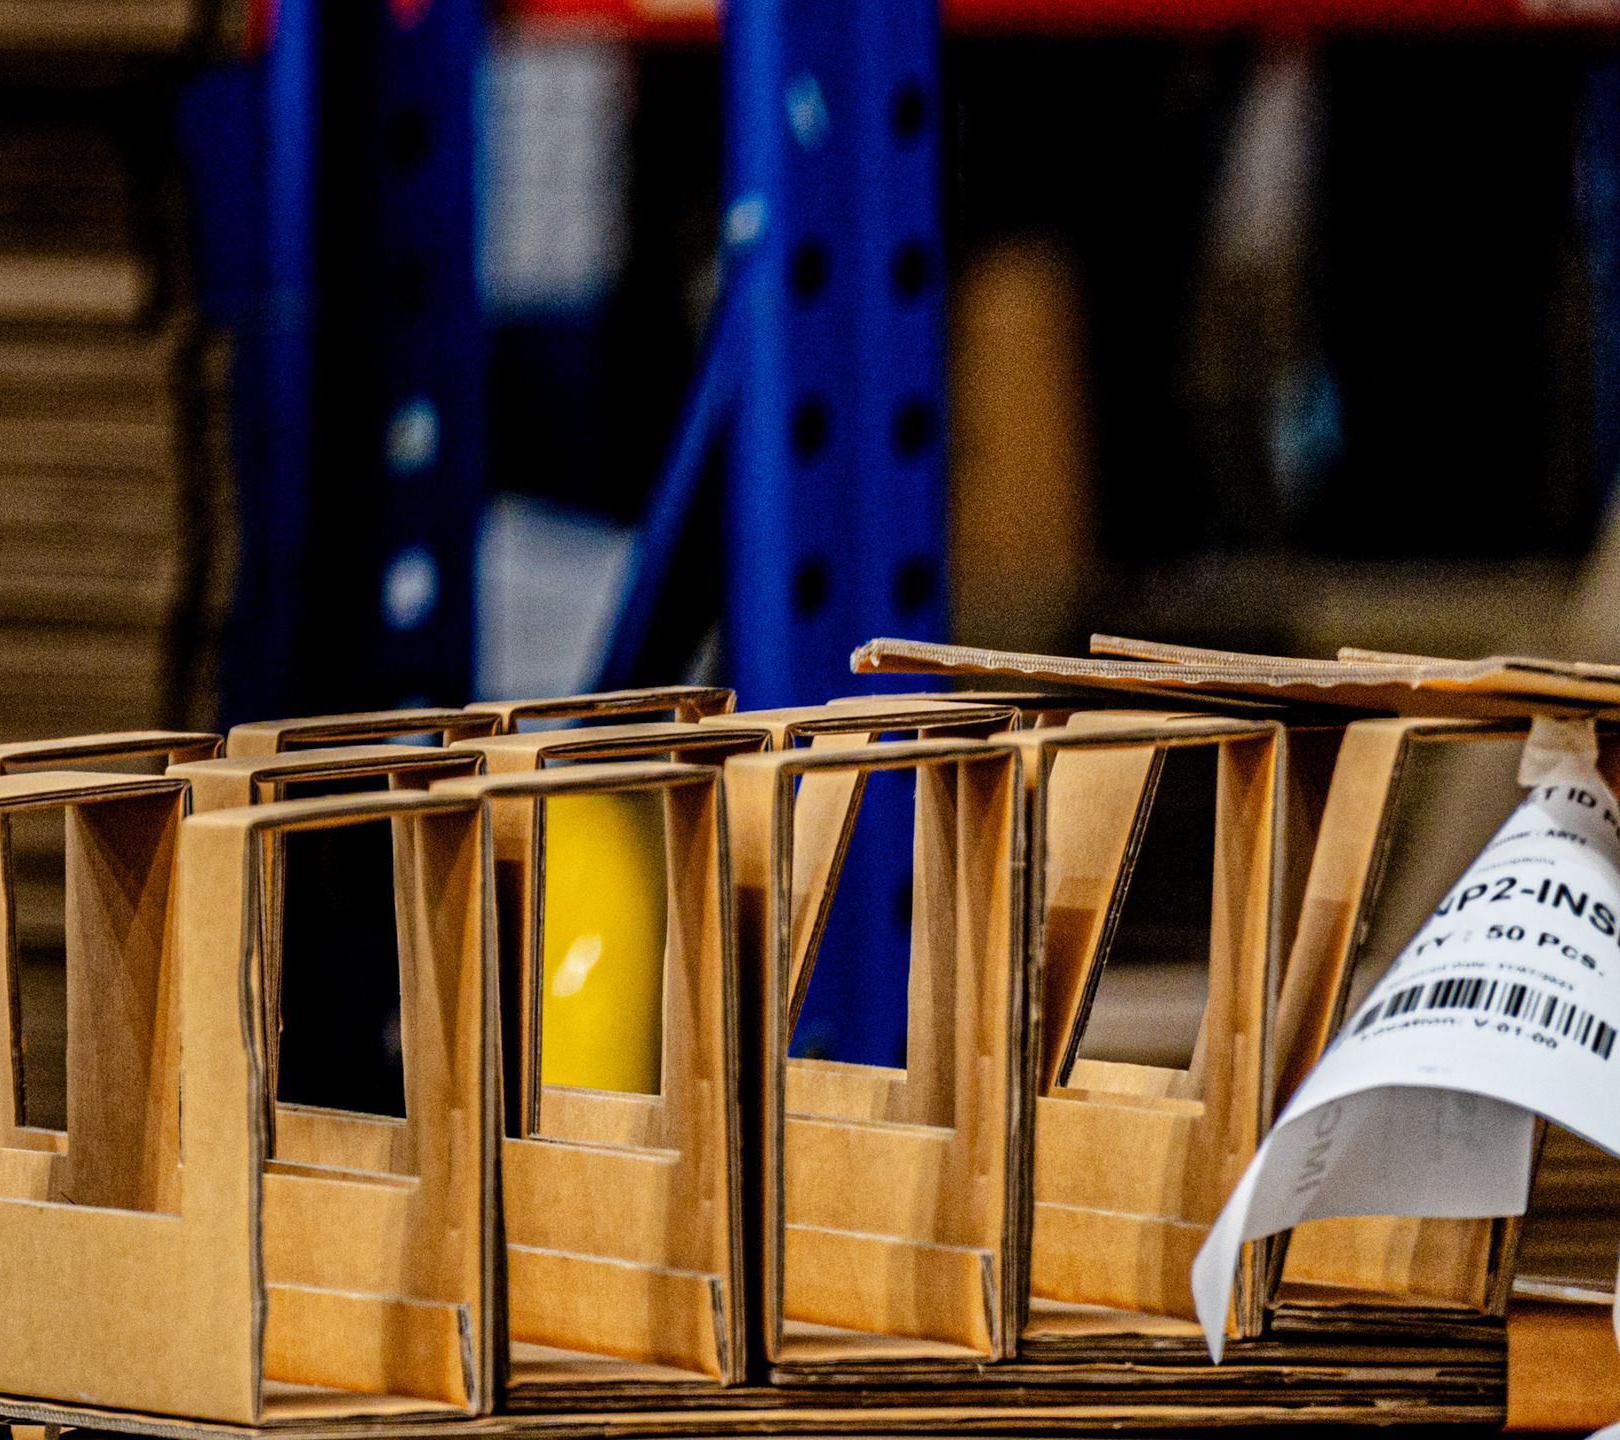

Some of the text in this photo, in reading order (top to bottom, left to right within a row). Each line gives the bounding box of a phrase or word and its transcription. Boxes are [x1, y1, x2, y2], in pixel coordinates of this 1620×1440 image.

[1567, 787, 1597, 809] ID
[1434, 876, 1620, 950] P2-INS
[1486, 923, 1526, 942] 50
